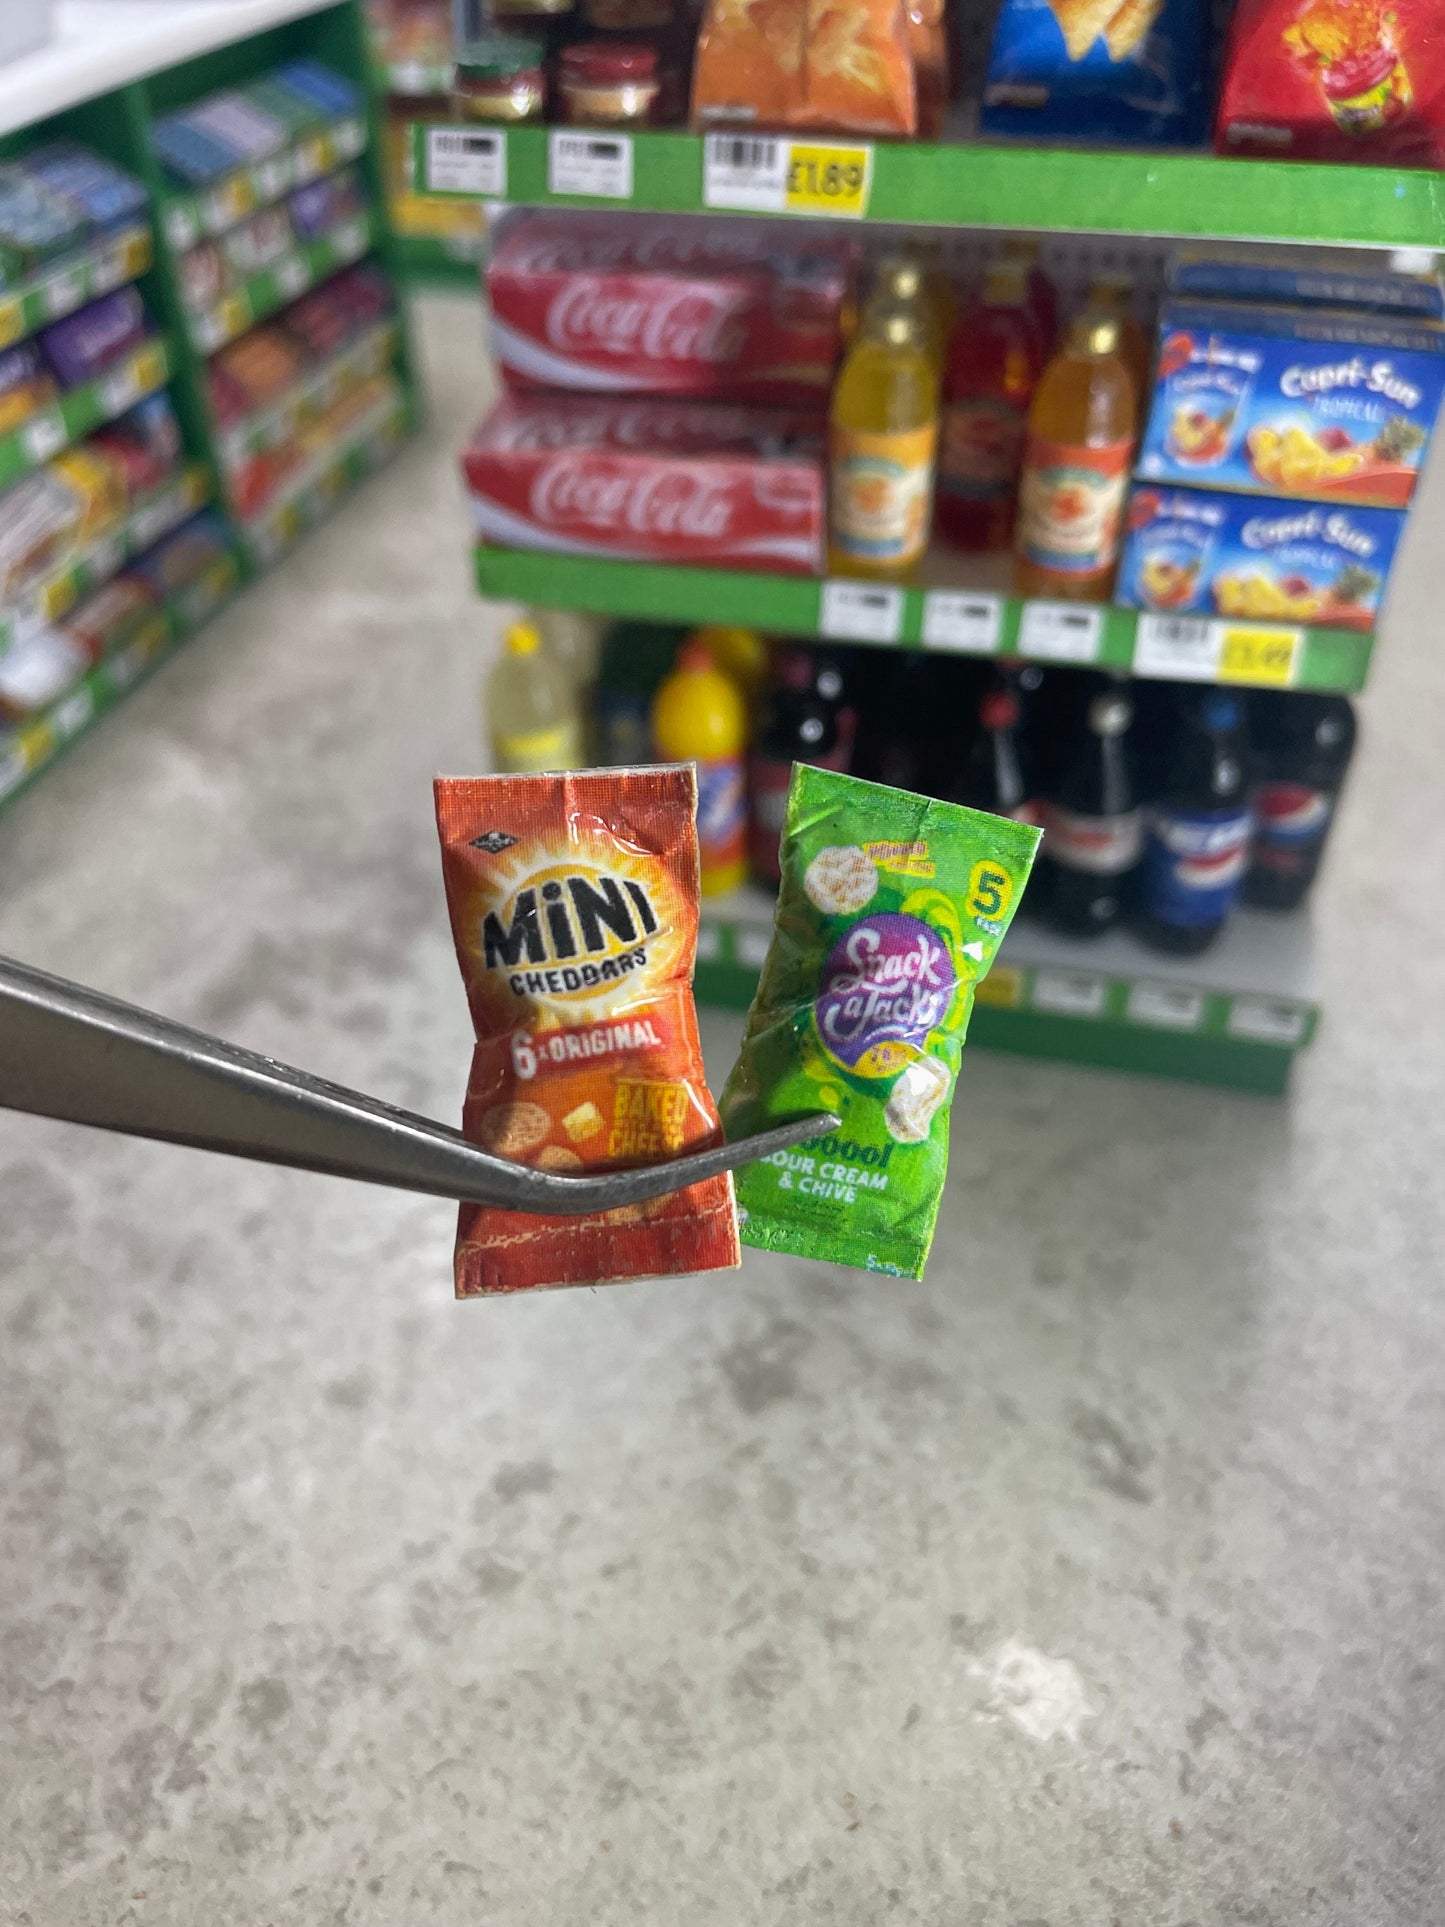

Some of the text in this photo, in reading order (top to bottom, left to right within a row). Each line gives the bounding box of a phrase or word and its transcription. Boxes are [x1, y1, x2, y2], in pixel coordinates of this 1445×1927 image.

[973, 869, 1005, 915] 5
[509, 948, 647, 997] CHEDDARS
[831, 927, 943, 993] Snack
[549, 1020, 662, 1062] ORIGINAL
[778, 1171, 858, 1204] & CHIVE
[819, 1161, 889, 1191] CREAM
